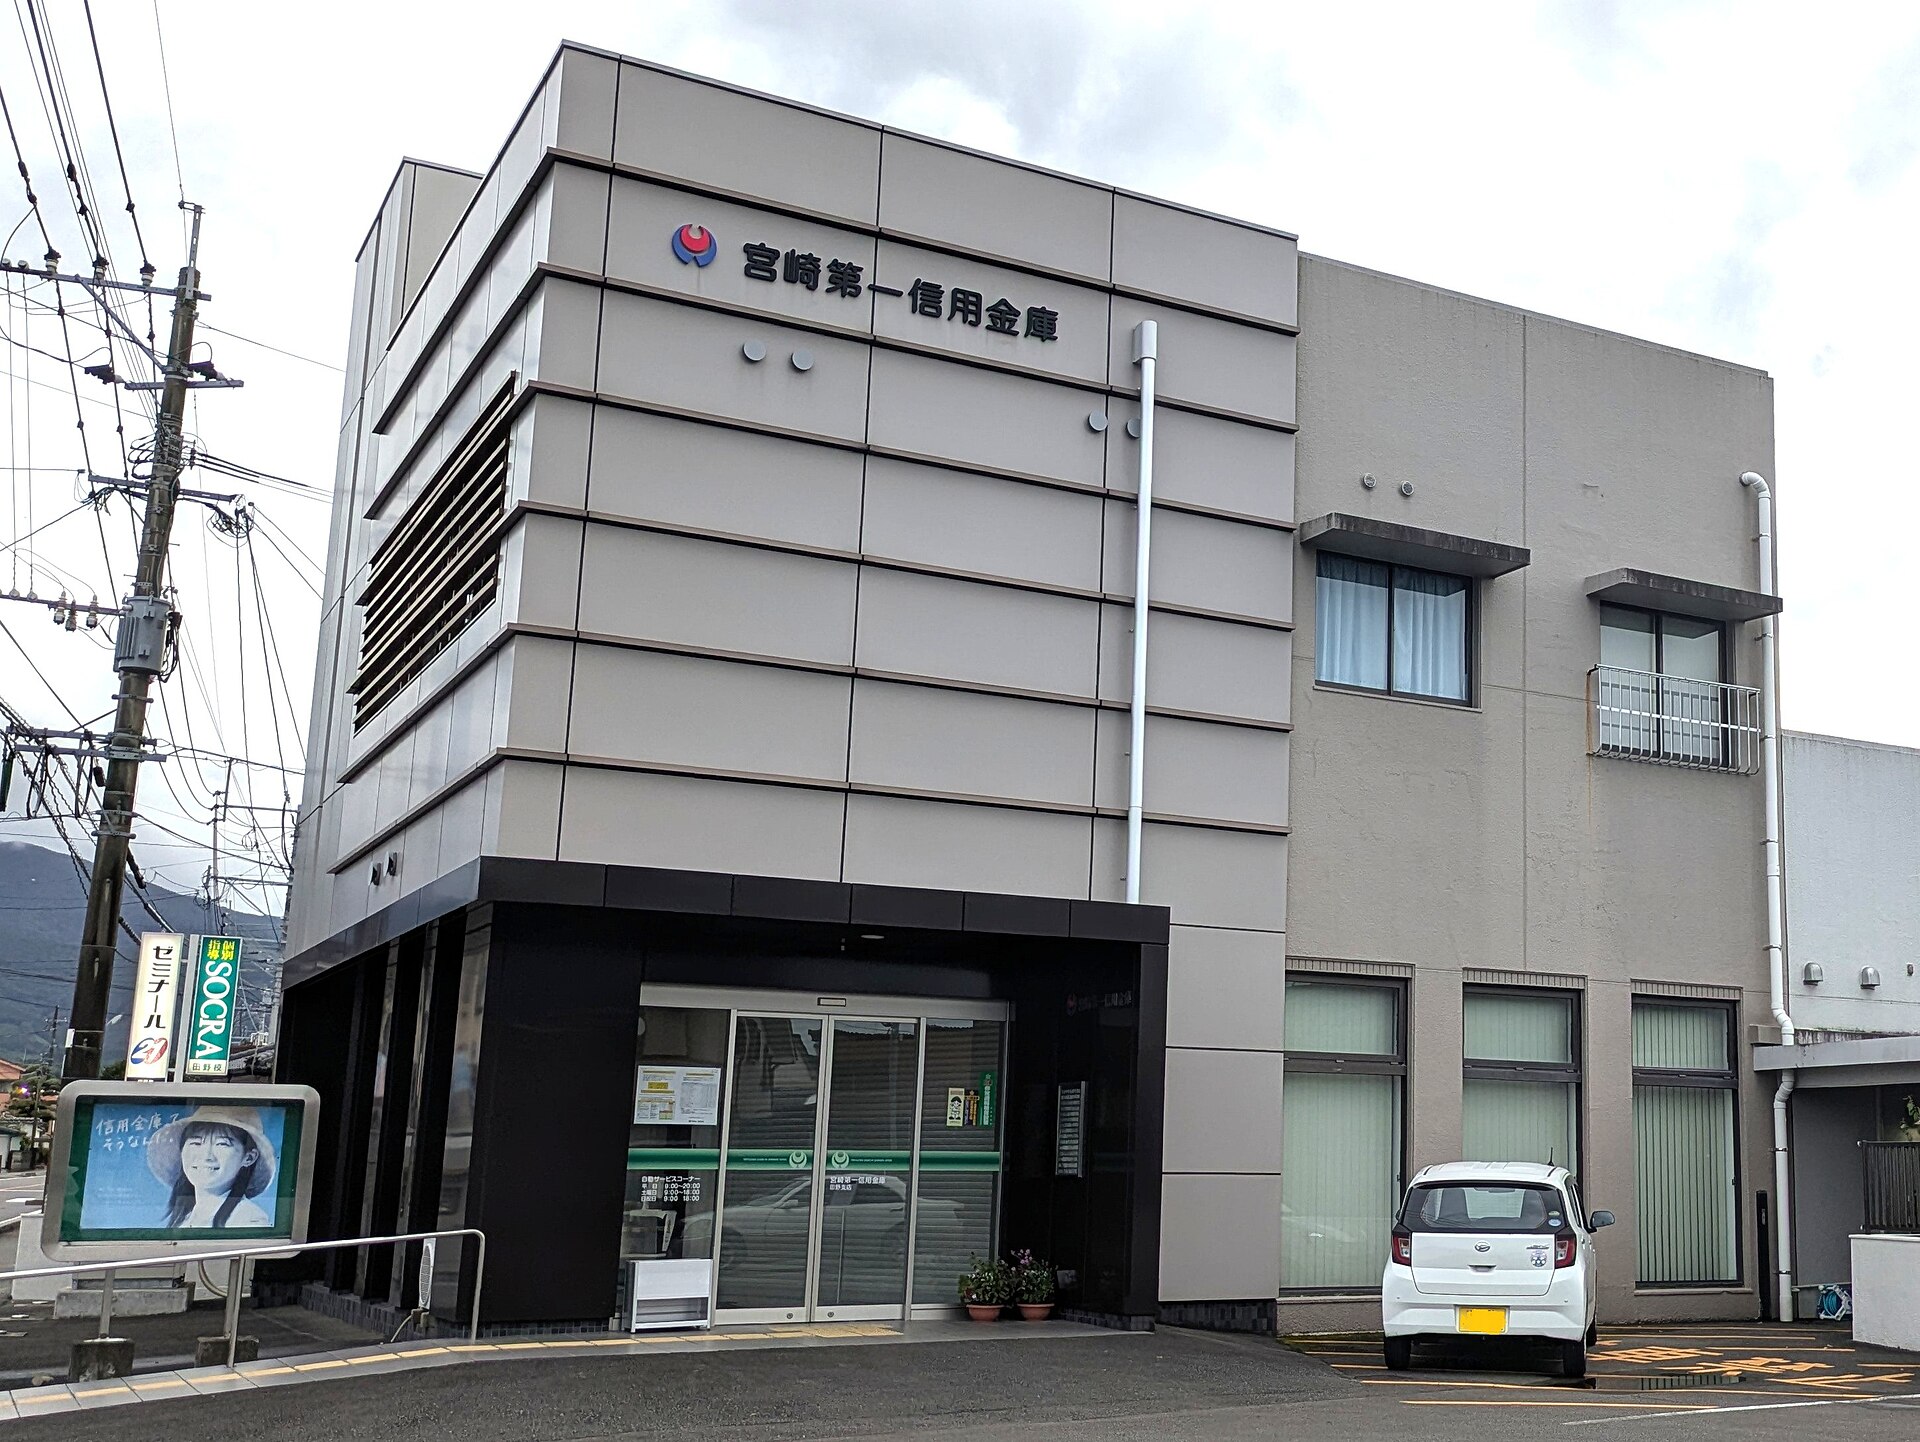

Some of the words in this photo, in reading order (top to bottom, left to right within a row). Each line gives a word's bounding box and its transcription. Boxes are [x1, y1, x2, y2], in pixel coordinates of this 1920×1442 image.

[743, 242, 1060, 342] 宮崎第一信用金庫
[143, 945, 174, 1029] ゼミナール
[195, 960, 233, 1059] SOCRA
[192, 1062, 222, 1072] 田野校
